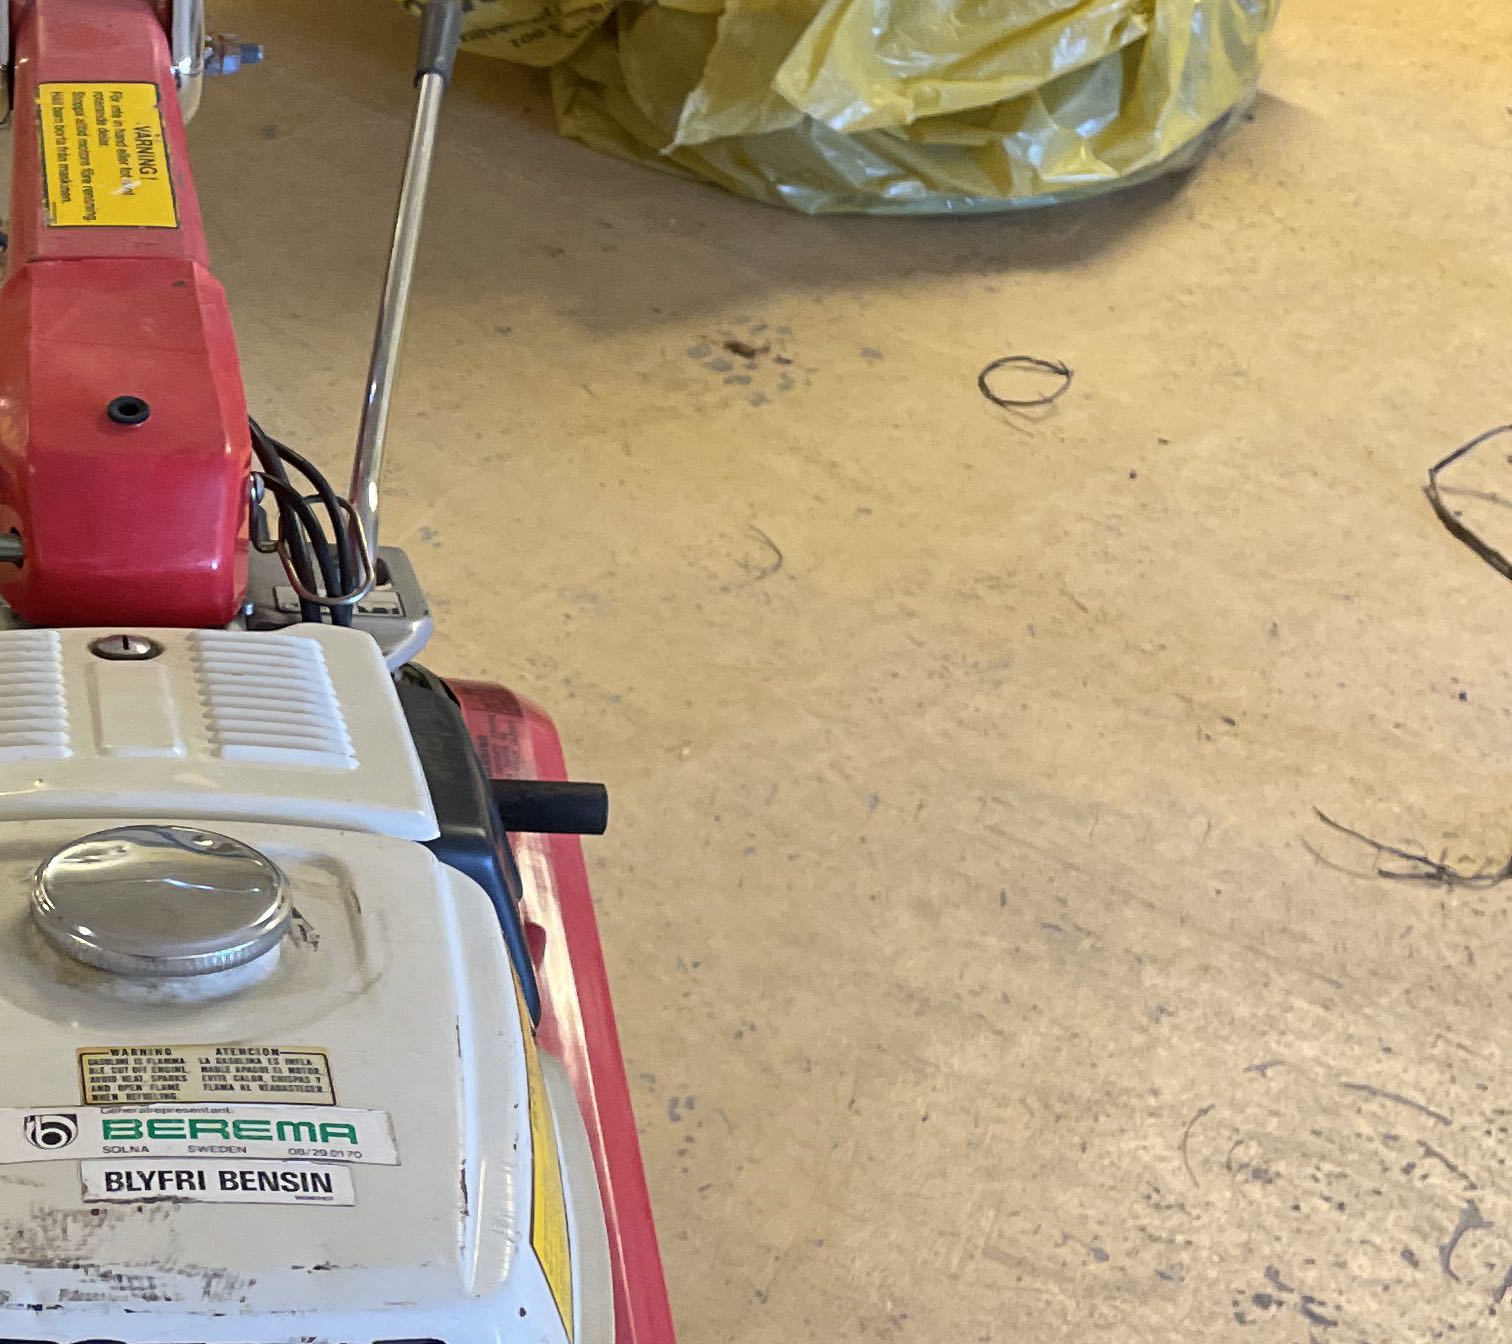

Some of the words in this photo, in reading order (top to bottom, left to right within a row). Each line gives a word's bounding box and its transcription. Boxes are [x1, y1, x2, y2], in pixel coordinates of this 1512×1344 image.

[110, 1048, 172, 1056] WARNING
[102, 1119, 359, 1145] BEREMA
[102, 1145, 150, 1154] SOLNA
[188, 1145, 246, 1154] SWEDEN
[105, 1170, 207, 1192] BLYFRI
[219, 1170, 334, 1193] BENSIN
